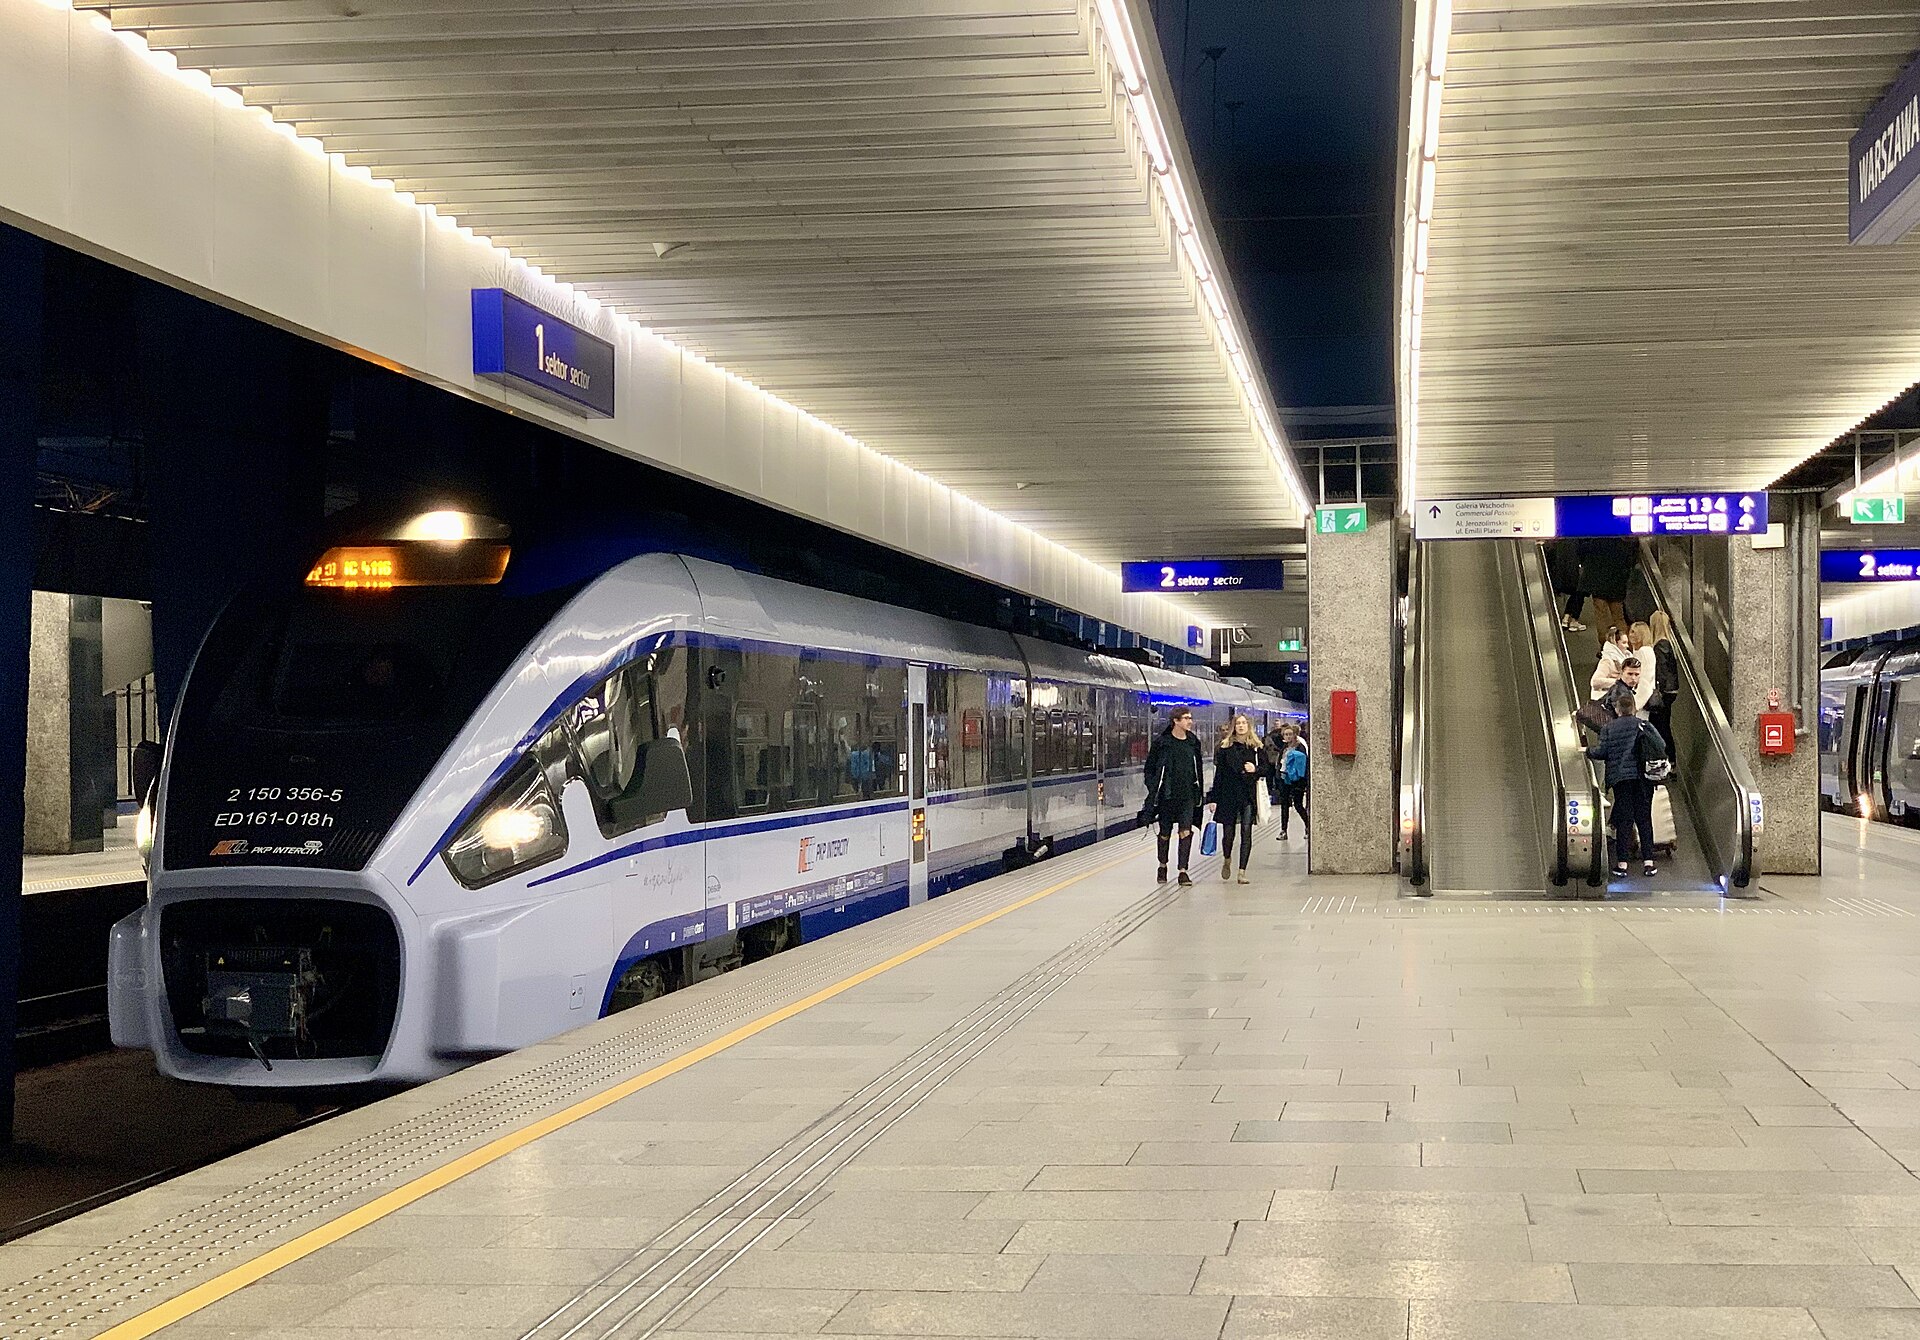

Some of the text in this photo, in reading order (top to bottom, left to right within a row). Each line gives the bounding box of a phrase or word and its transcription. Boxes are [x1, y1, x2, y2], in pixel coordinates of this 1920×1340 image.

[1858, 94, 1920, 204] WARSZAWA
[535, 323, 591, 390] 1 sektor sector
[1455, 502, 1479, 510] Galeria
[1689, 498, 1697, 512] 1
[1701, 498, 1712, 512] 3
[1714, 497, 1727, 512] 4
[1465, 520, 1509, 528] Jerozolimskie
[1860, 554, 1875, 576] 2
[1877, 563, 1913, 576] sektor
[1160, 566, 1244, 588] 2 sektor sector
[1292, 664, 1300, 674] 3
[227, 787, 344, 802] 2 150 356-5
[214, 811, 335, 828] ED161-018h
[250, 846, 324, 855] PKP INTERCITY
